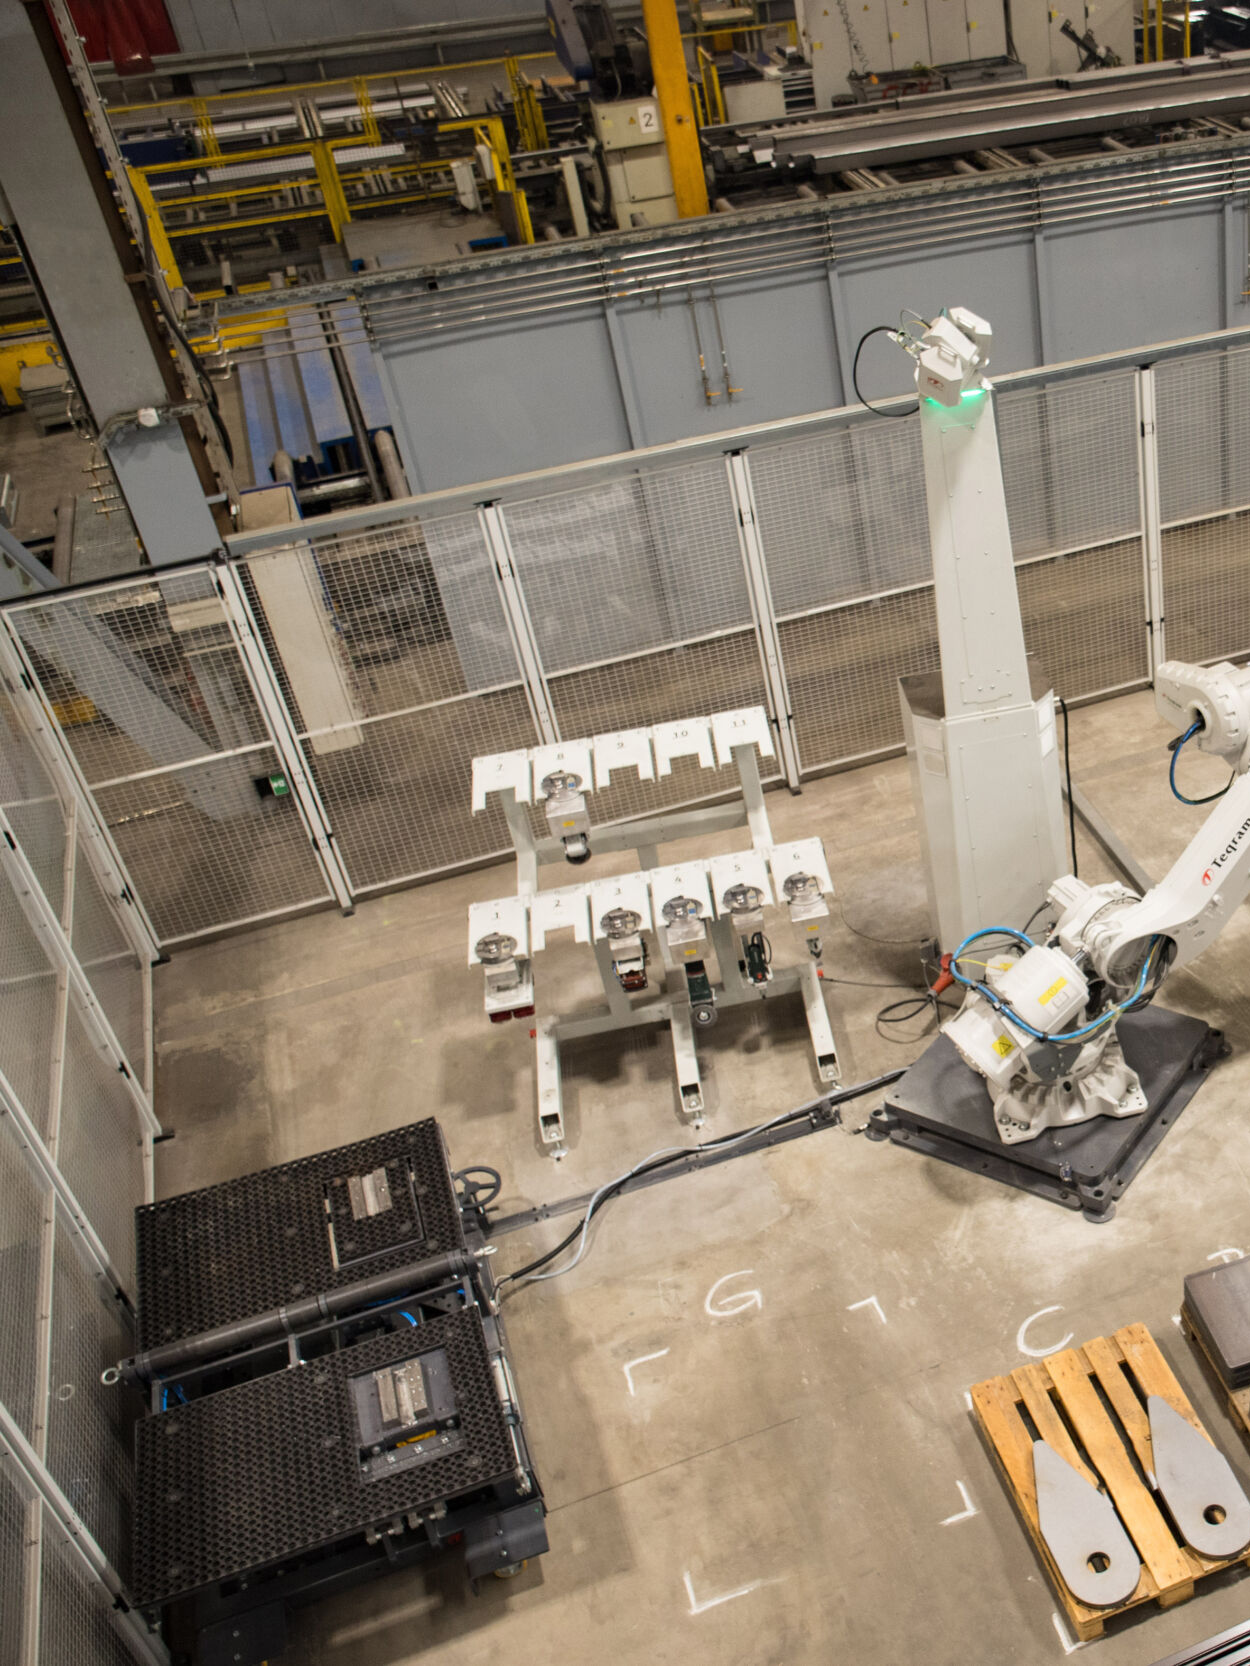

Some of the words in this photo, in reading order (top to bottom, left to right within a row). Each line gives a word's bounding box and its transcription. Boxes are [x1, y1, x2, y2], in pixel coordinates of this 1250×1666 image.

[643, 112, 654, 128] 2
[704, 1270, 762, 1317] G
[1016, 1305, 1074, 1357] C
